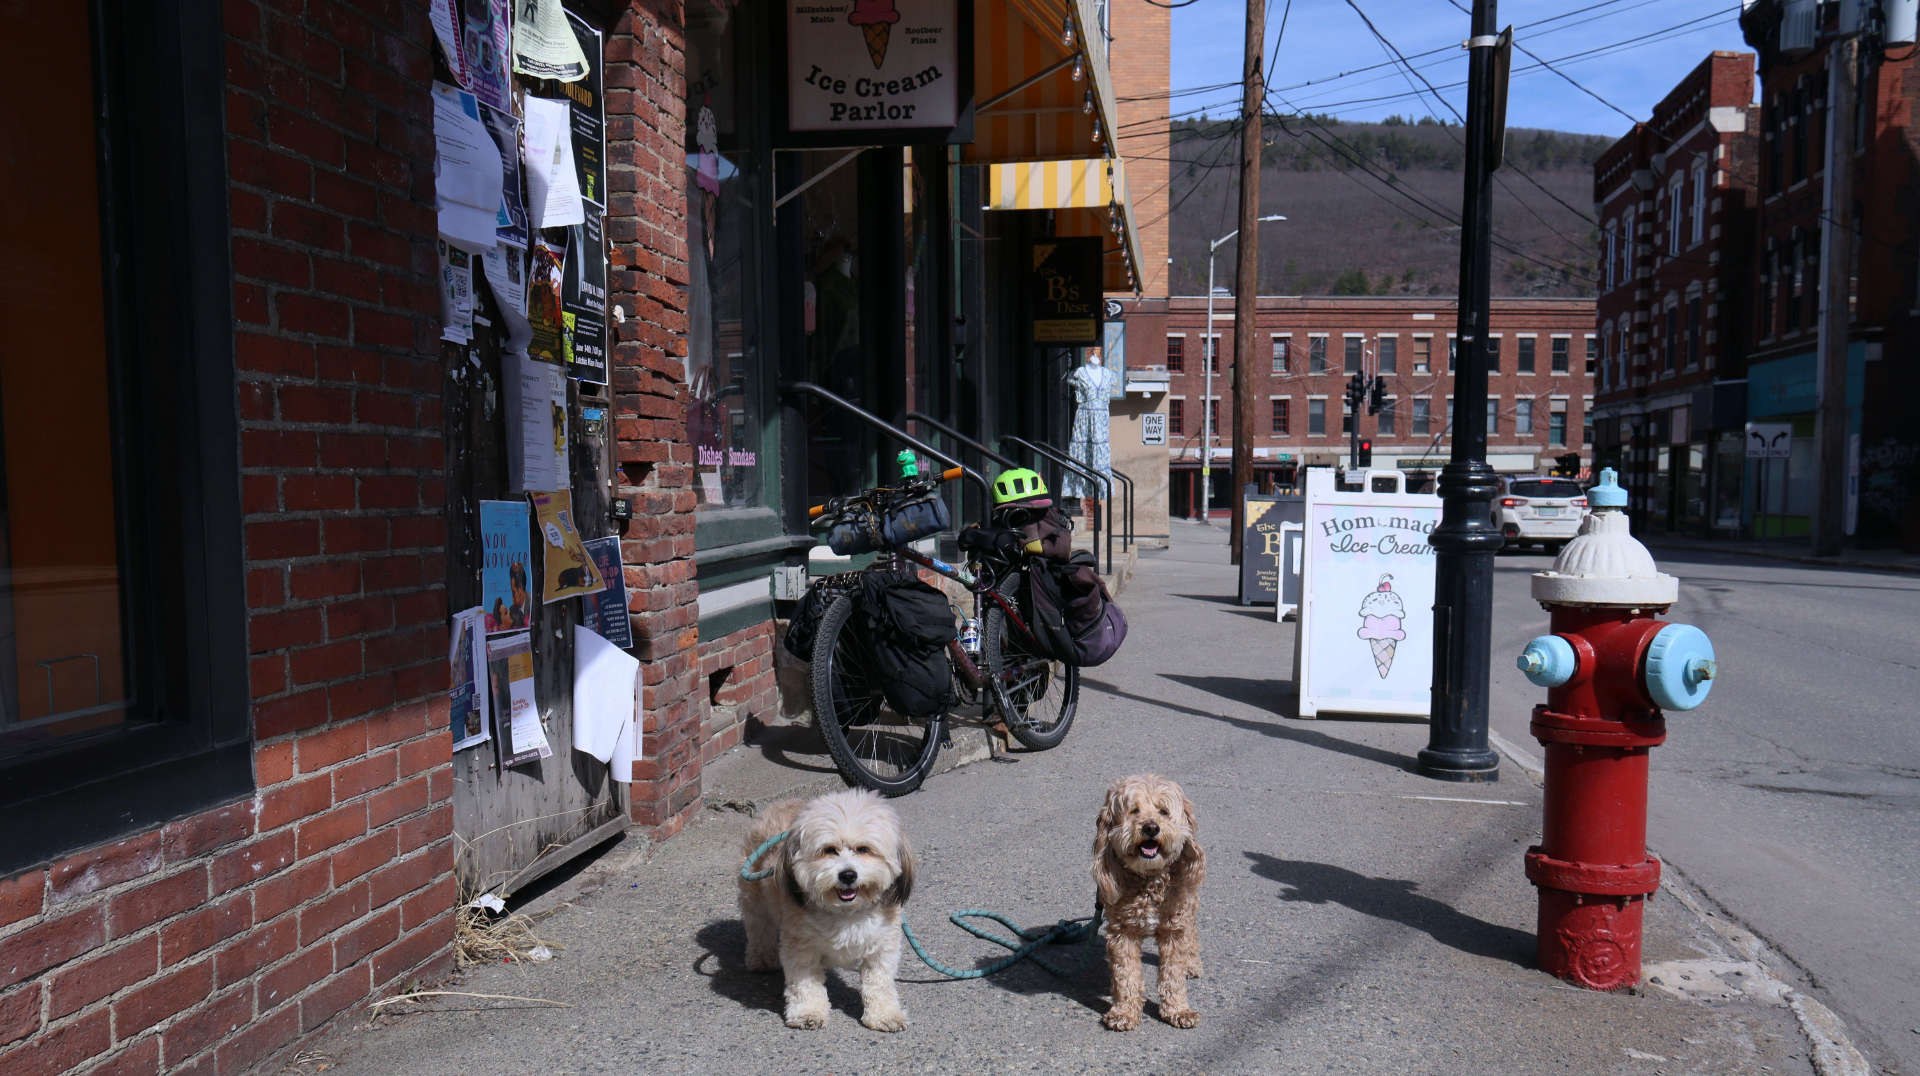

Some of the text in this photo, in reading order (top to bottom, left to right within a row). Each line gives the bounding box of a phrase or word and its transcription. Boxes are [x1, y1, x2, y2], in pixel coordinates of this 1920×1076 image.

[810, 15, 835, 24] Malts
[905, 26, 943, 35] Rootbeer
[911, 36, 937, 45] Floats
[804, 64, 943, 98] Ice Cream
[829, 101, 917, 121] Parlor
[1047, 275, 1081, 302] B's
[1145, 415, 1163, 425] ONE
[1145, 426, 1163, 436] WAY
[698, 445, 756, 467] Dishes Sundaes
[1256, 522, 1277, 532] The
